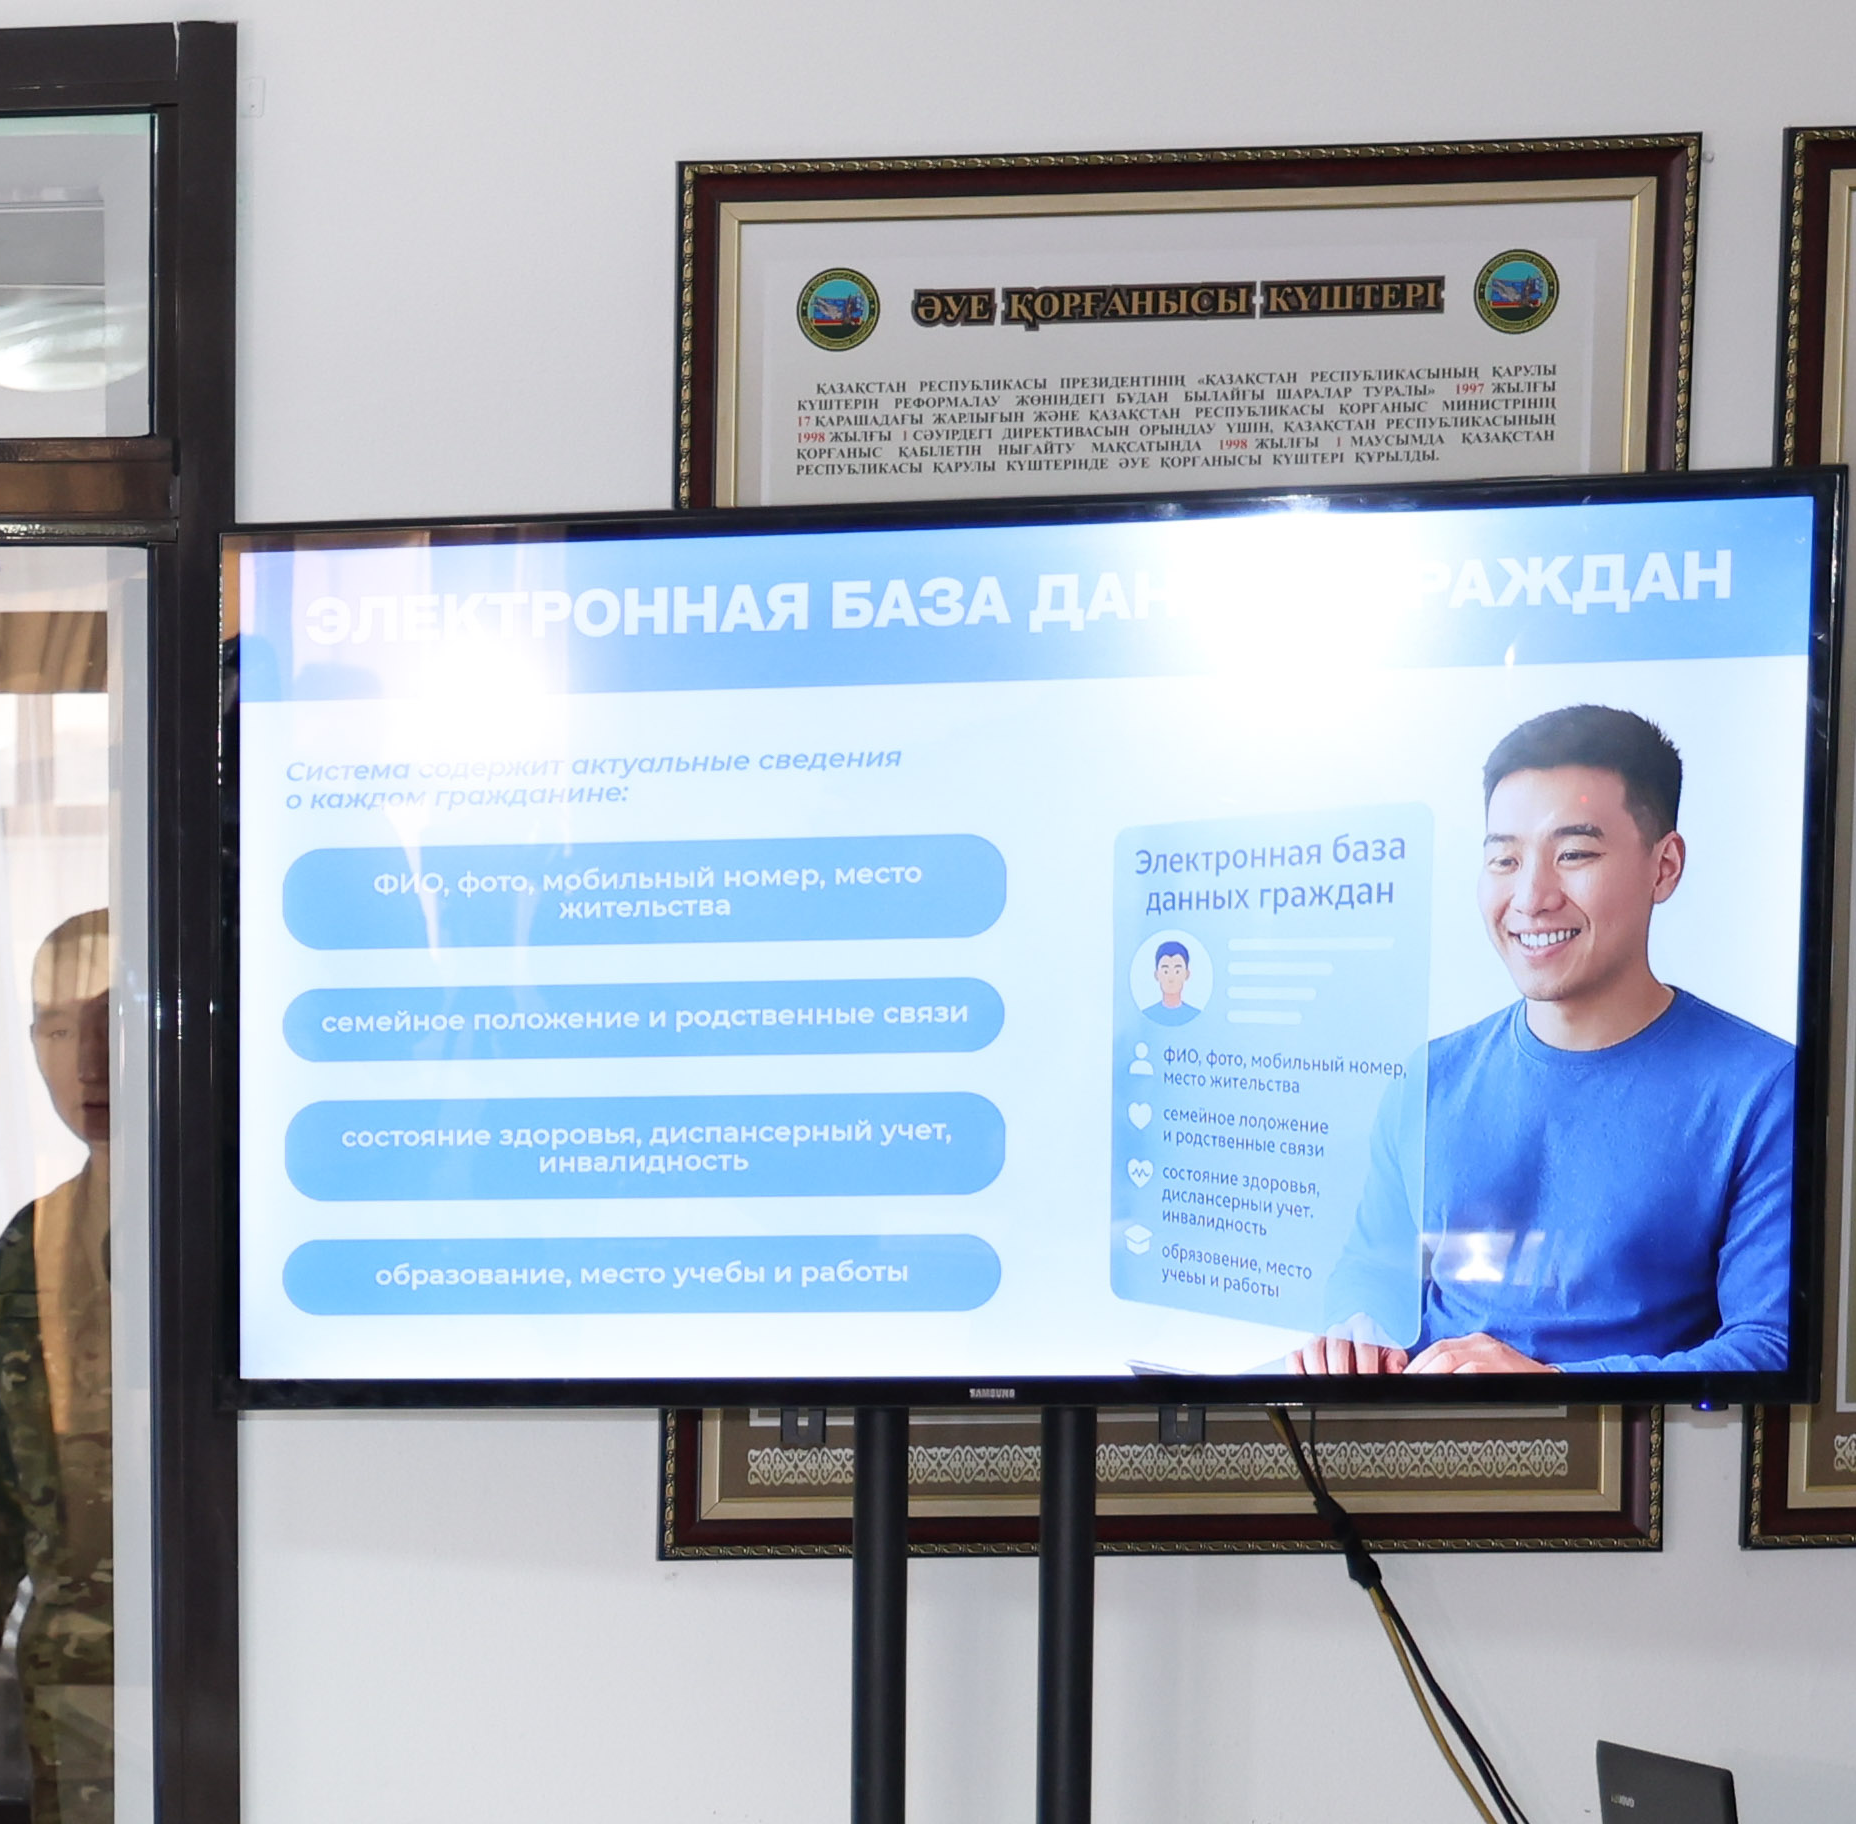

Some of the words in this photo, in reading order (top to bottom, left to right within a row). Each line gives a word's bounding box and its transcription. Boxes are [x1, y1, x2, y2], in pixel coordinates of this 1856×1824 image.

[914, 292, 993, 325] ӘУЕ
[1006, 286, 1251, 331] ҚОРҒАНЫСЫ
[1263, 281, 1441, 315] КҮШТЕРІ
[817, 382, 906, 395] ҚАЗАҚСТАН
[920, 379, 1047, 392] РЕСПУБЛИКАСЫ
[1061, 375, 1185, 389] ПРЕЗИДЕНТІНІҢ
[1198, 372, 1296, 386] «ҚАЗАҚСТАН
[1311, 368, 1478, 382] РЕСПУБЛИКАСЫНЫҢ
[1493, 365, 1556, 378] ҚАРУЛЫ
[797, 433, 825, 443] 1998
[1002, 425, 1129, 440] ДИРЕКТИВАСЫН
[1140, 423, 1215, 436] ОРЫНДАУ
[1227, 422, 1273, 433] ҮШІН,
[1284, 419, 1375, 433] ҚАЗАҚСТАН
[1387, 414, 1555, 429] РЕСПУБЛИКАСЫНЫҢ
[306, 582, 810, 644] ЭЛЕКТРОННАЯ
[832, 576, 1011, 629] БАЗА
[1413, 549, 1733, 616] РАЖДАН
[286, 761, 410, 784] Система
[572, 755, 751, 780] актуальные
[759, 748, 903, 774] сведения
[286, 794, 302, 811] о
[436, 785, 630, 812] гражданине:
[1135, 843, 1322, 877] Электронная
[1332, 832, 1407, 864] база
[374, 870, 449, 899] ФИО,
[458, 869, 536, 898] фото,
[543, 864, 714, 894] мобильный
[724, 868, 826, 893] номер,
[835, 865, 923, 885] место
[560, 898, 732, 920] жительства
[1146, 887, 1249, 916] данных
[1260, 881, 1394, 916] граждан
[322, 1009, 465, 1034] семейное
[474, 1009, 641, 1032] положение
[649, 1010, 666, 1028] и
[676, 1006, 876, 1034] родственные
[884, 1004, 969, 1025] связи
[1164, 1072, 1206, 1087] место
[1211, 1075, 1300, 1094] жительства
[342, 1127, 491, 1148] состояние
[500, 1126, 643, 1152] здоровья,
[649, 1119, 873, 1149] диспансерный
[881, 1122, 952, 1148] учет,
[1280, 1141, 1324, 1158] связи
[539, 1152, 750, 1176] инвалидность
[1163, 1167, 1238, 1186] состояние
[1162, 1210, 1267, 1236] инвалидность
[375, 1261, 573, 1291] образование,
[581, 1266, 665, 1284] место
[673, 1260, 766, 1289] учебы
[775, 1265, 791, 1283] и
[801, 1259, 909, 1288] работы
